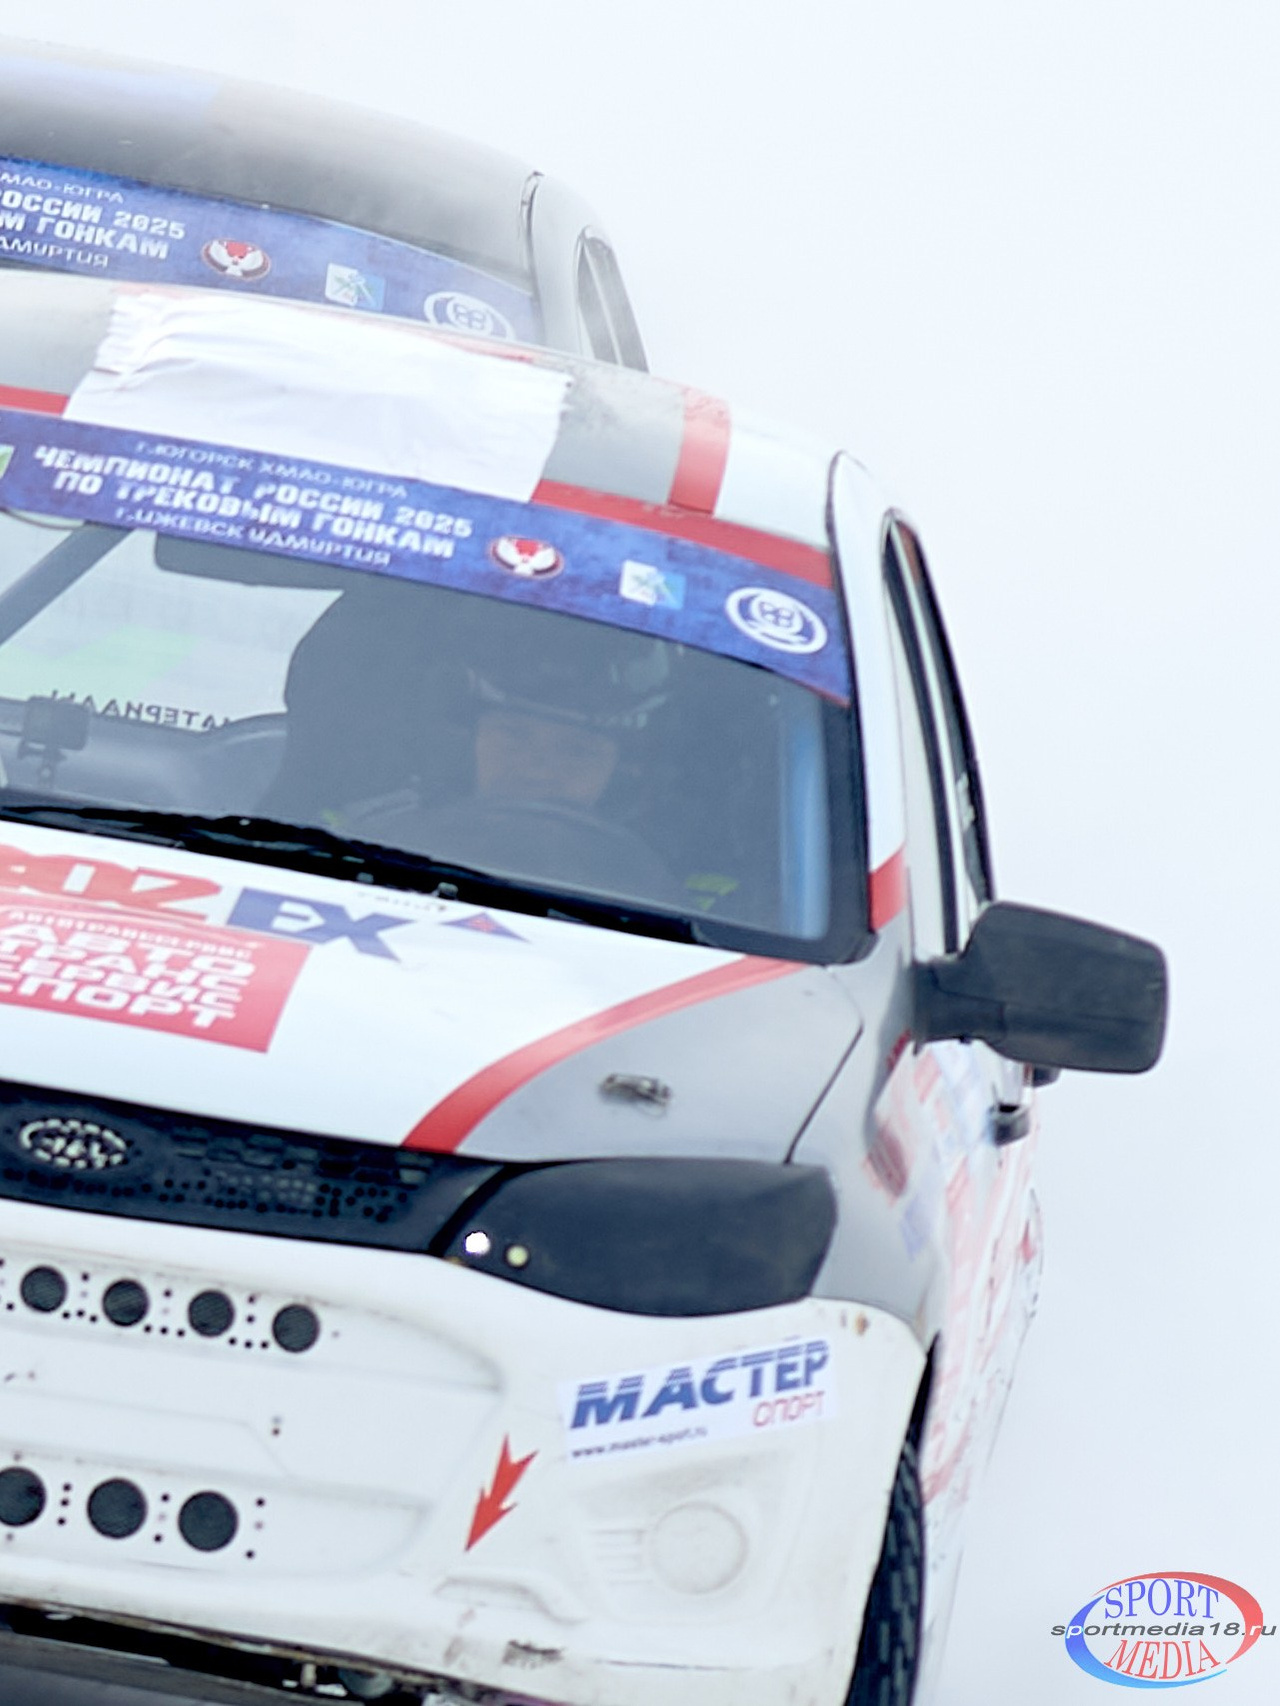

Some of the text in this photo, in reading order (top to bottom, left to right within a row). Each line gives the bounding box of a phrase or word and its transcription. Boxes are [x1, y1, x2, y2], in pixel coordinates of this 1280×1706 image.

[36, 216, 170, 260] ГОНКАМ
[113, 210, 186, 240] 2025
[33, 445, 474, 538] ЧЕМПИОНАТ РОССИИ 2025
[53, 470, 456, 559] ПО ТРЕКОВЫМ ГОНКАМ
[570, 1340, 830, 1429] МАСТЕР
[752, 1390, 825, 1428] СПОРТ
